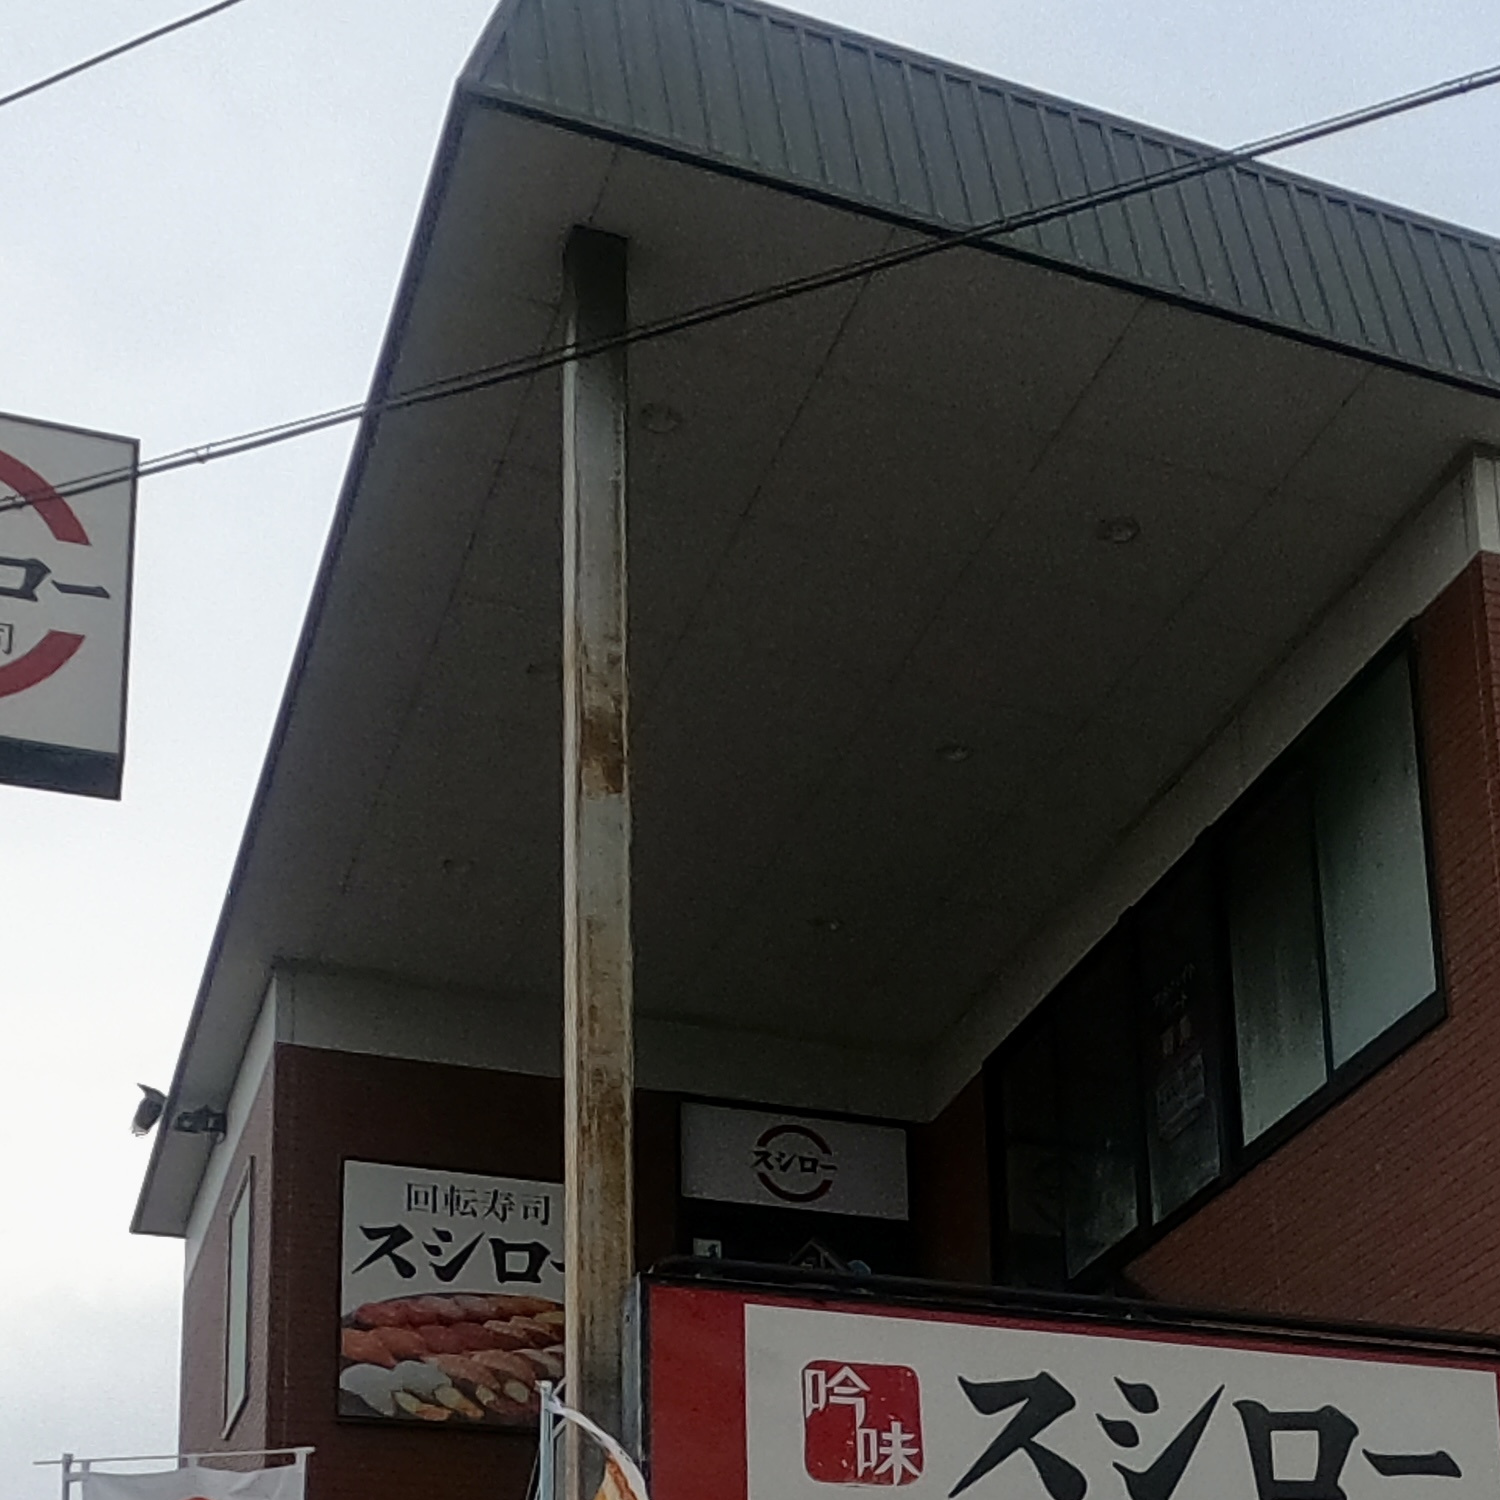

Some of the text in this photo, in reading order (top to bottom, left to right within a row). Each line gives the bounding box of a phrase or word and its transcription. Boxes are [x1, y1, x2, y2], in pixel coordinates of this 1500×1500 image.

[751, 1148, 839, 1175] スシロー
[405, 1182, 551, 1226] 回転寿司
[352, 1225, 566, 1283] スシロ
[804, 1365, 923, 1486] 吟味
